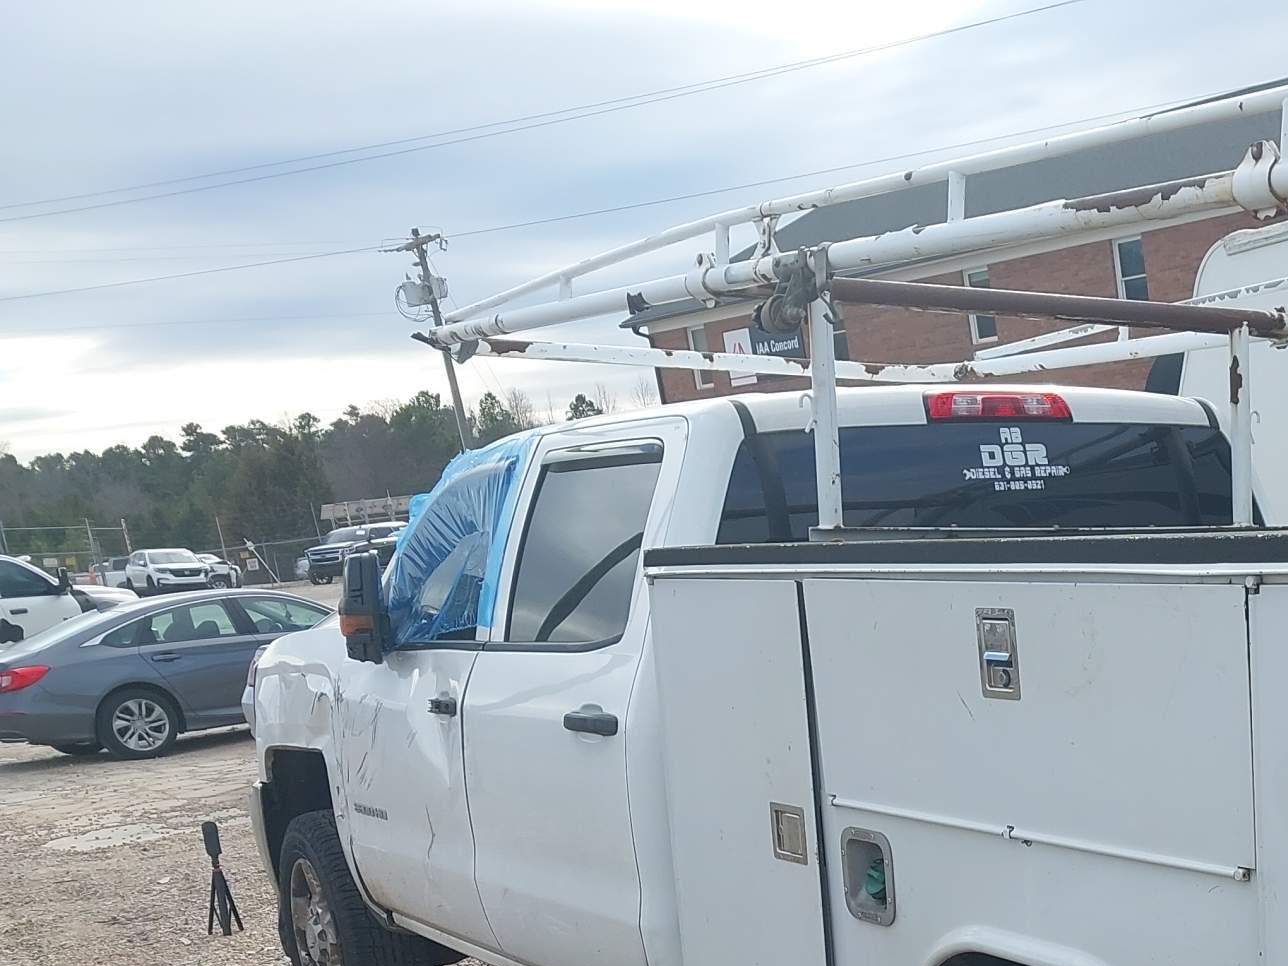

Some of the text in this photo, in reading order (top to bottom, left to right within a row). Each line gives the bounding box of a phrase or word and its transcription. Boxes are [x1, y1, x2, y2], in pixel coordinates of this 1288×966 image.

[755, 336, 799, 354] IAA Concord
[999, 427, 1022, 443] AB
[979, 443, 1049, 467] DGR
[969, 467, 1001, 479] DIESEL
[1014, 466, 1032, 478] GAS
[1034, 465, 1065, 477] REPAIR
